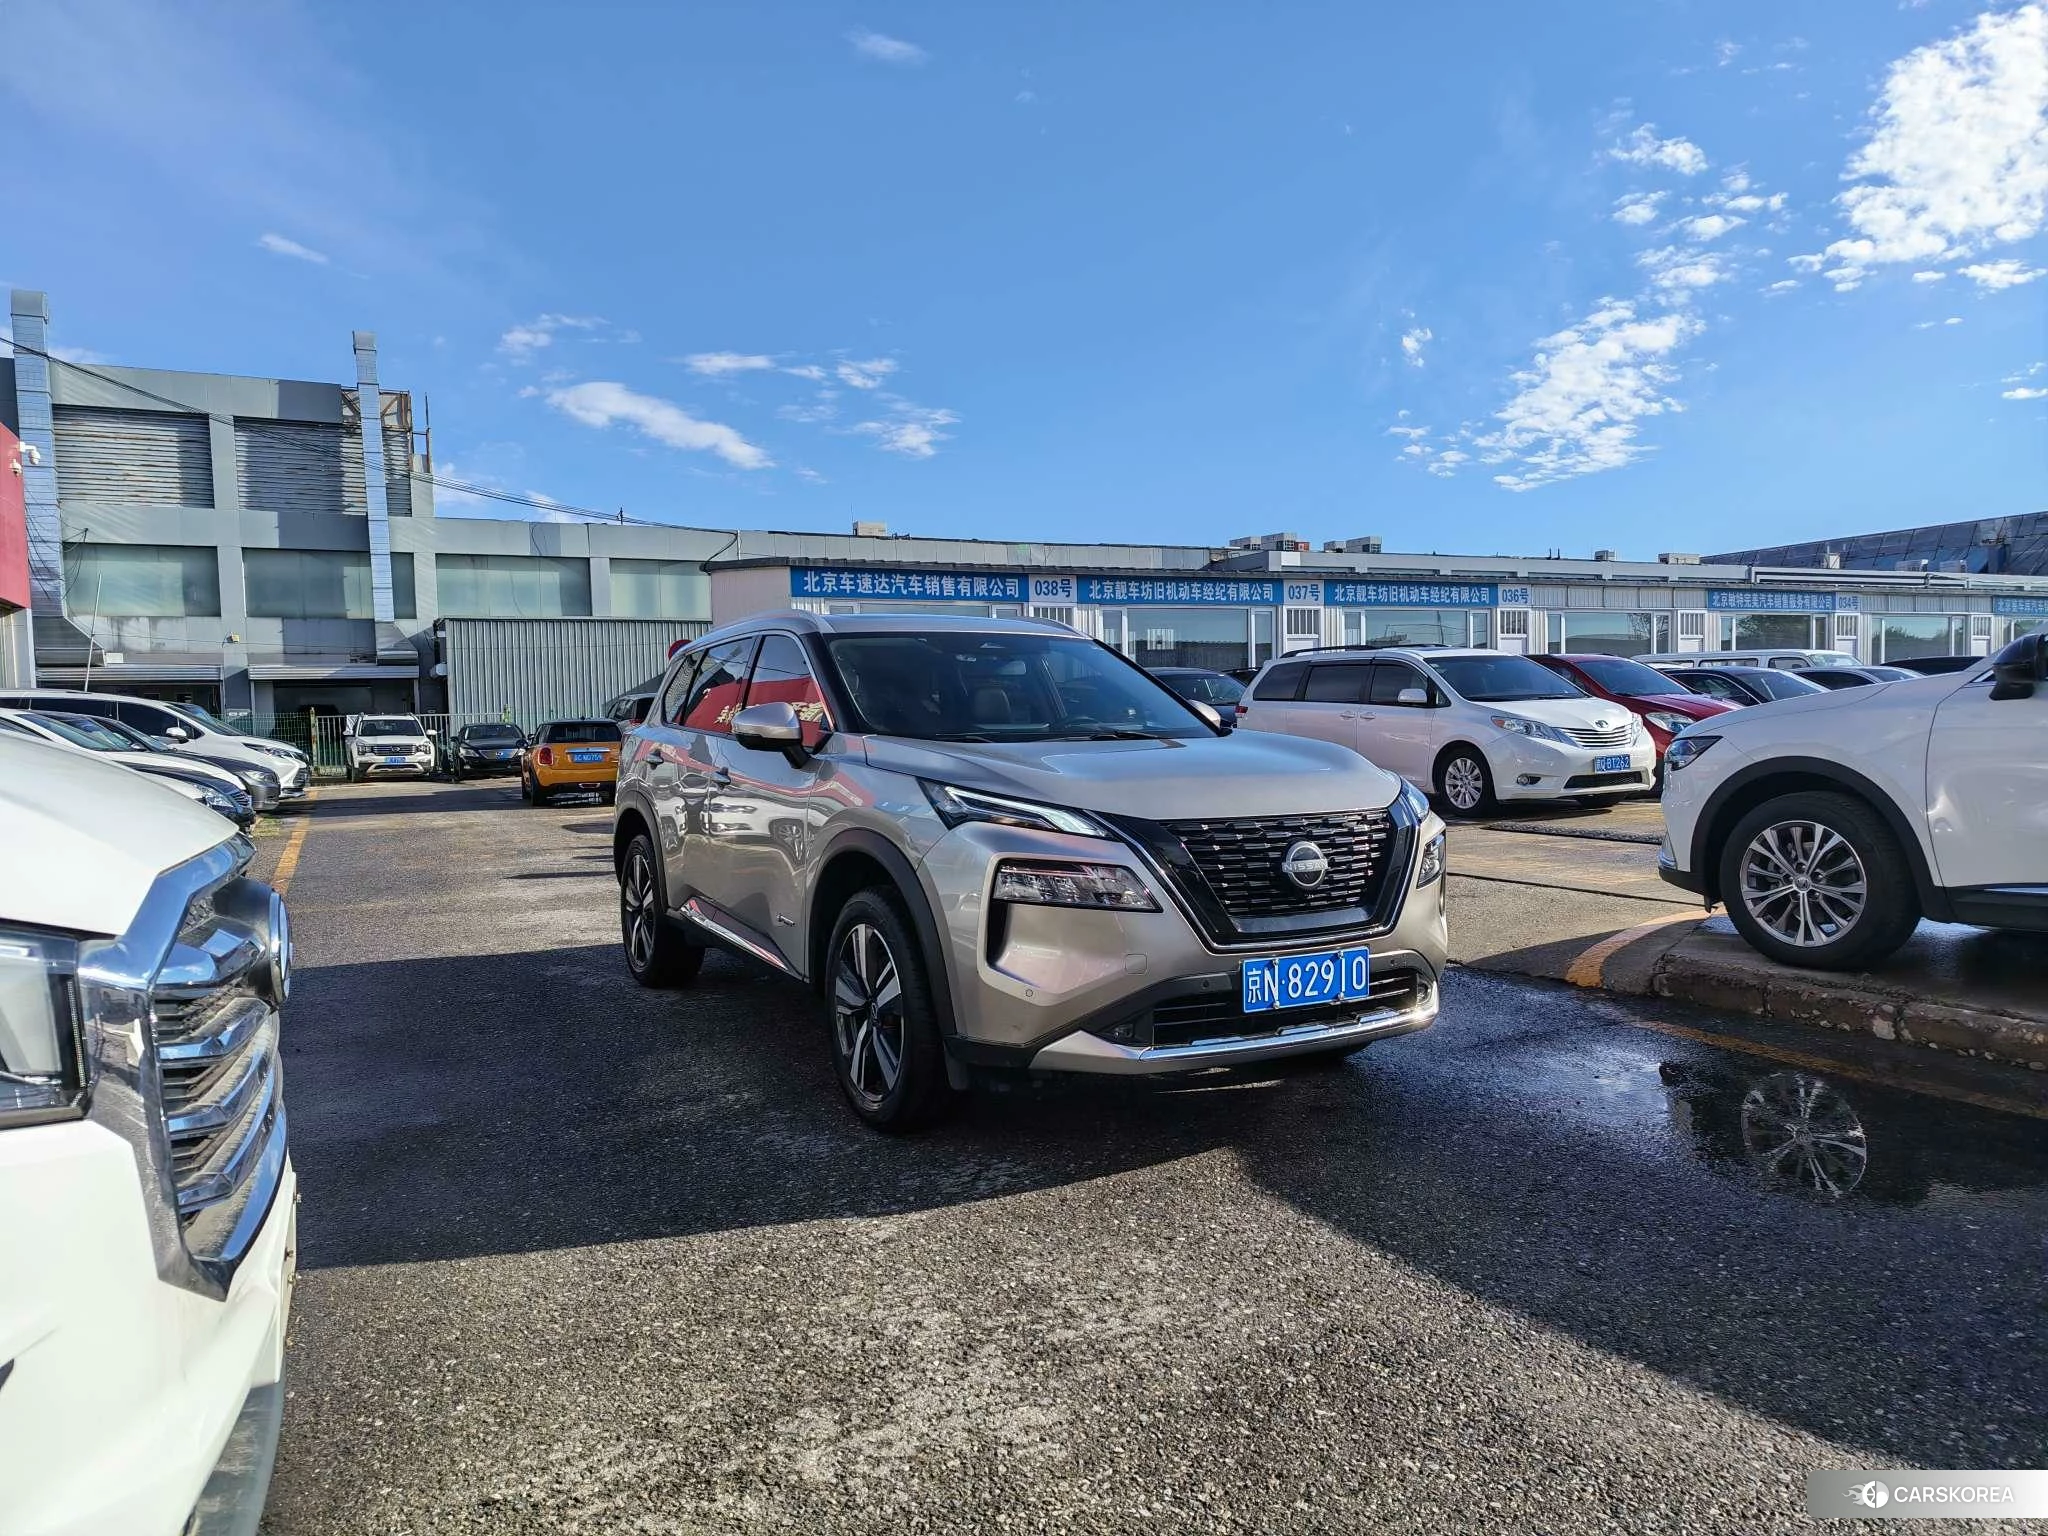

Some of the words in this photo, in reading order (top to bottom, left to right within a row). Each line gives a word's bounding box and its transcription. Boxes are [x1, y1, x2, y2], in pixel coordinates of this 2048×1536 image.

[803, 570, 1020, 598] 北京车速达汽车销售有限公司
[1034, 579, 1073, 598] 038号
[1088, 580, 1274, 601] 北京靓车坊旧机动车经纪有限公司
[1288, 584, 1321, 601] 037号
[1334, 584, 1490, 603] 北京靓车坊旧机动车经纪有限公司
[1502, 587, 1530, 604] 036号
[1283, 860, 1328, 871] NISSAN
